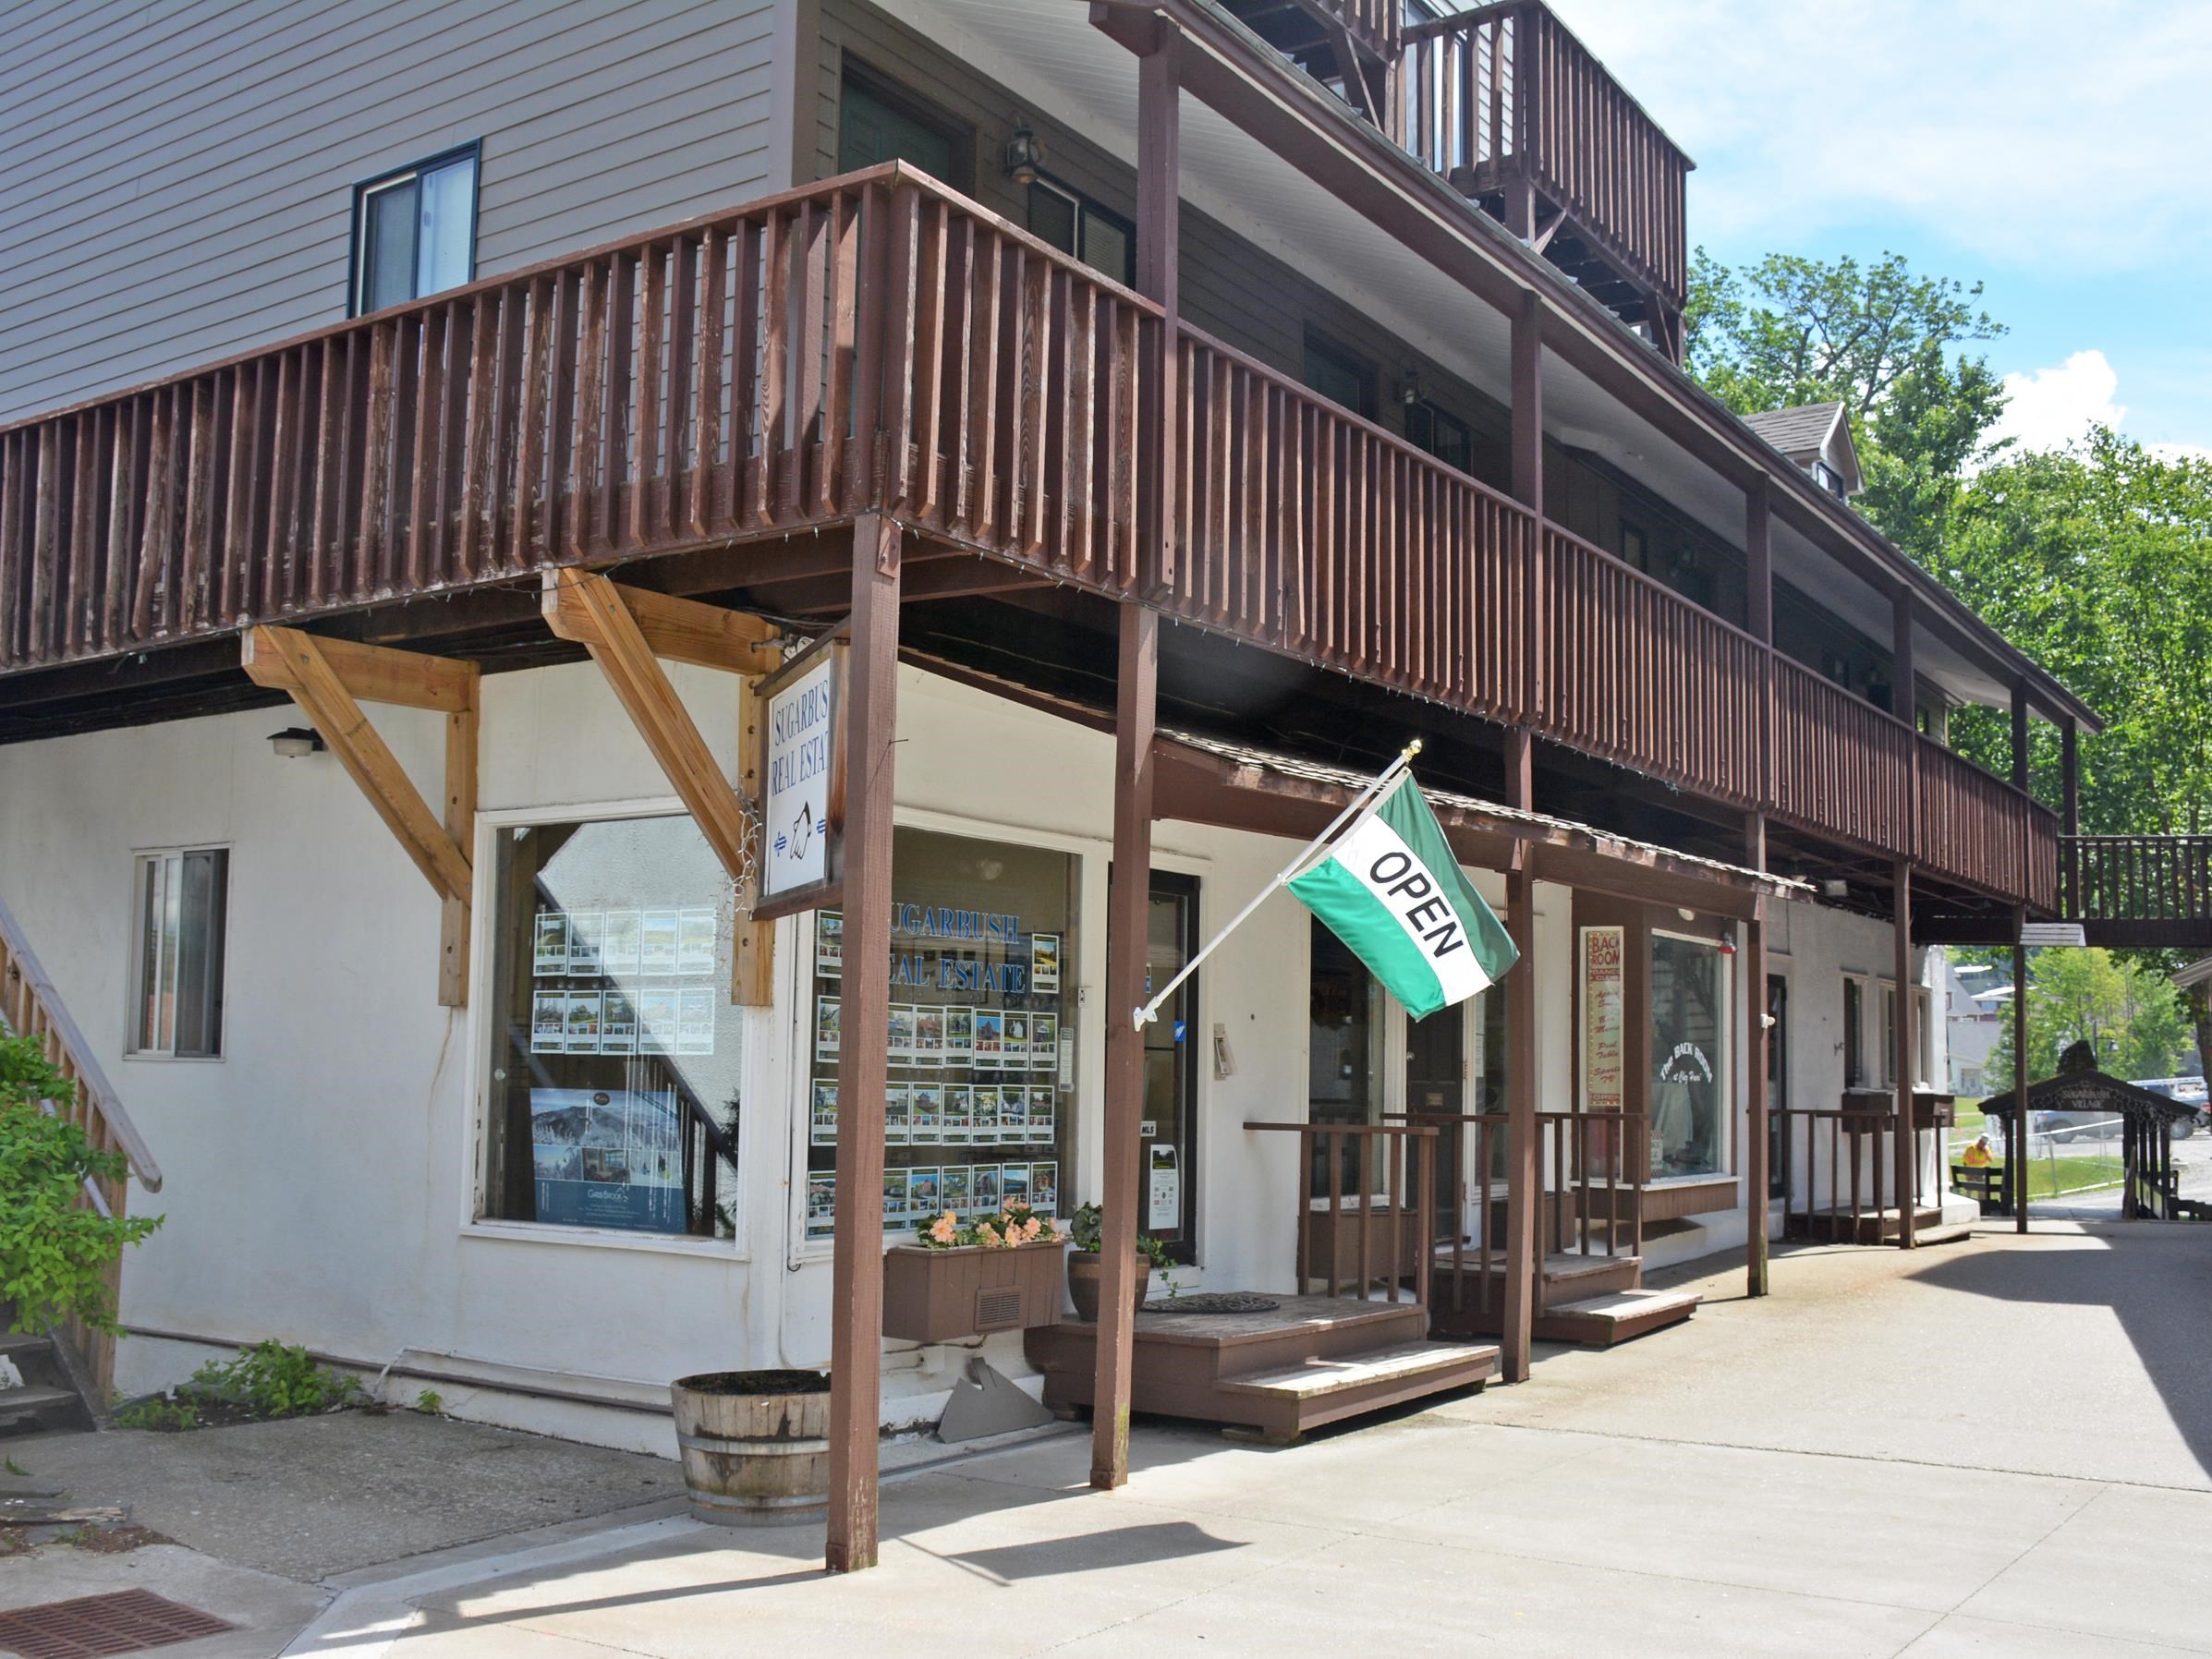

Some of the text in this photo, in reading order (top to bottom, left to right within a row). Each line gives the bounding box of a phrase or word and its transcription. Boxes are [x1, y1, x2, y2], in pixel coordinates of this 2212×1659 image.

[774, 680, 828, 747] SUGARBUS
[772, 731, 828, 796] REAL ESTA
[890, 902, 1019, 945] UGARBUSH
[1369, 852, 1464, 958] OPEN
[938, 958, 1026, 994] ESTATE
[1673, 1042, 1694, 1060] BACK
